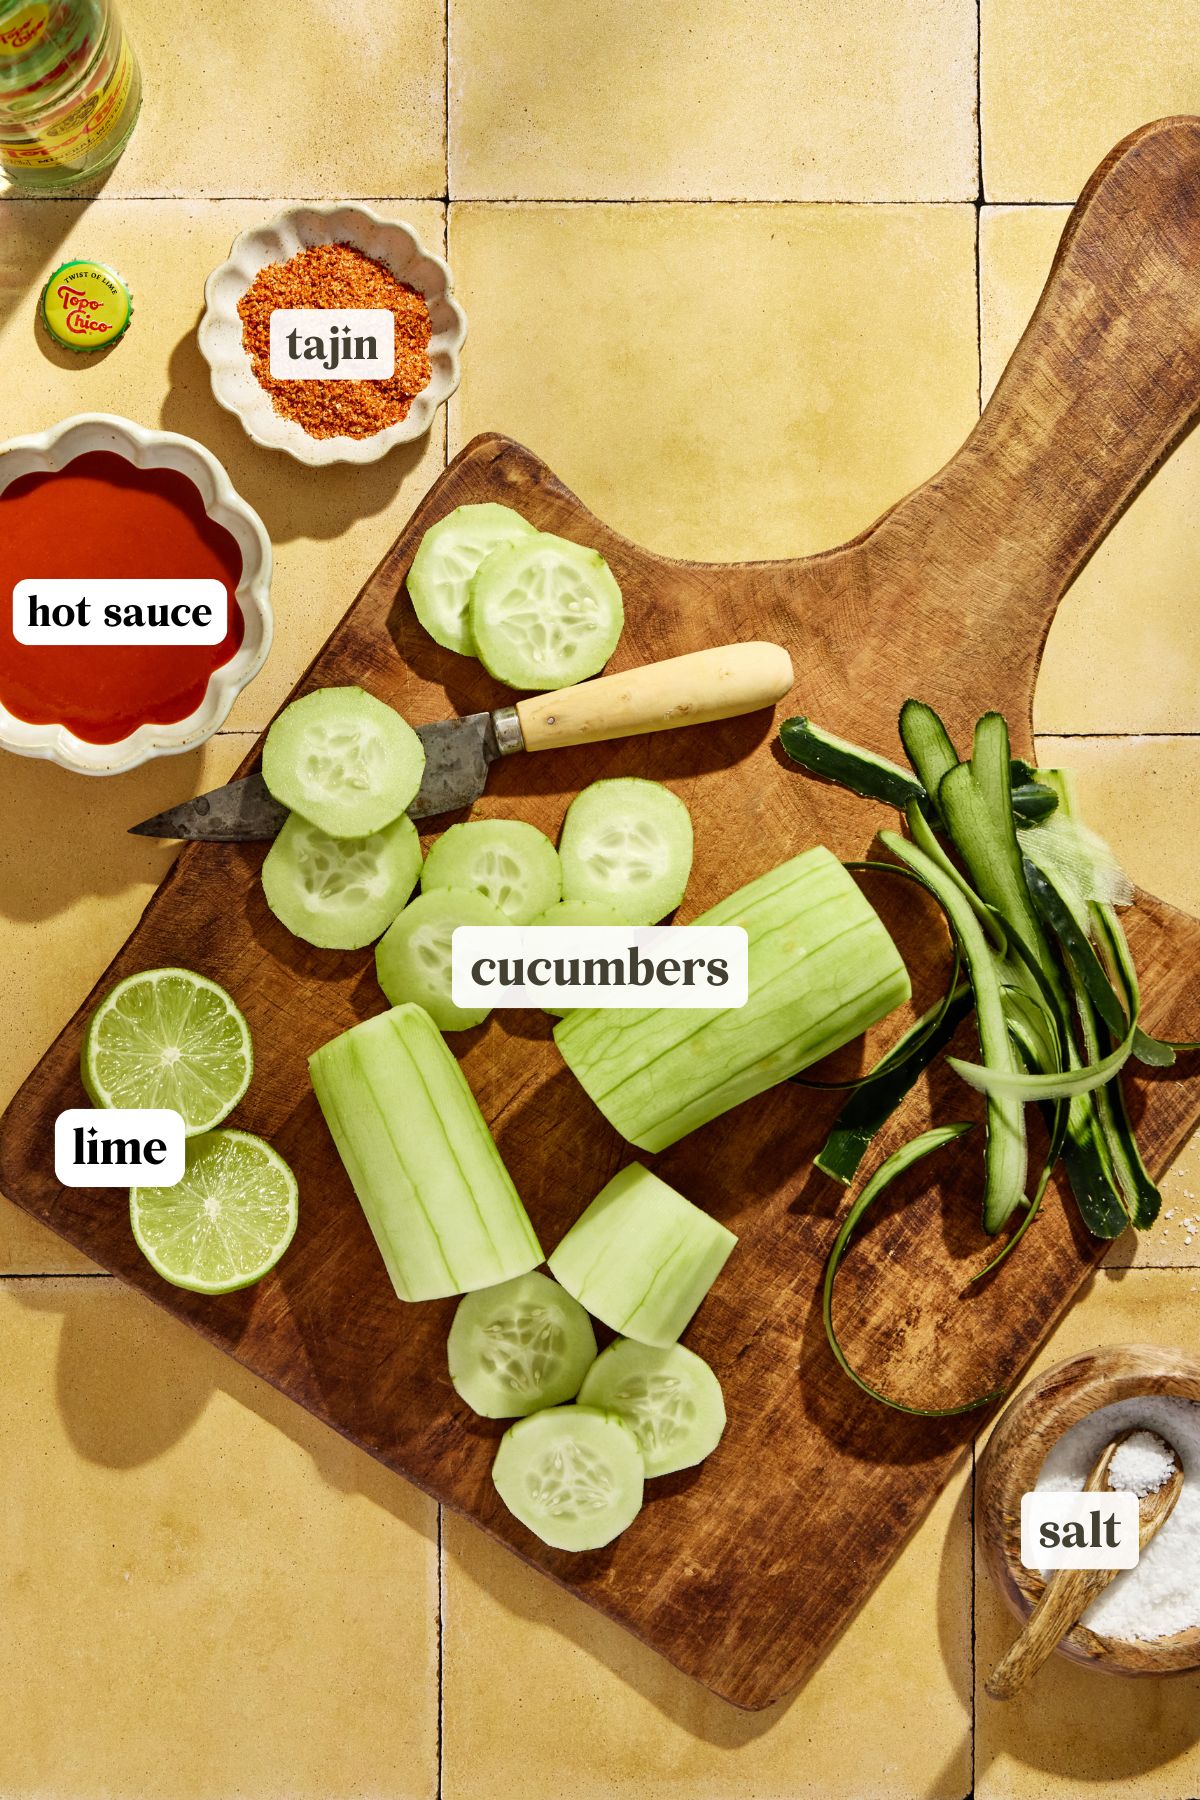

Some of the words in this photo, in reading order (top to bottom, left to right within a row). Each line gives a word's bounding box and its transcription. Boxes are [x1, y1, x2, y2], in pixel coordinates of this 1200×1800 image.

[64, 271, 88, 284] TWIST
[91, 272, 102, 280] OF
[101, 278, 118, 295] LIME
[57, 285, 104, 311] Topo
[66, 309, 113, 334] Chico
